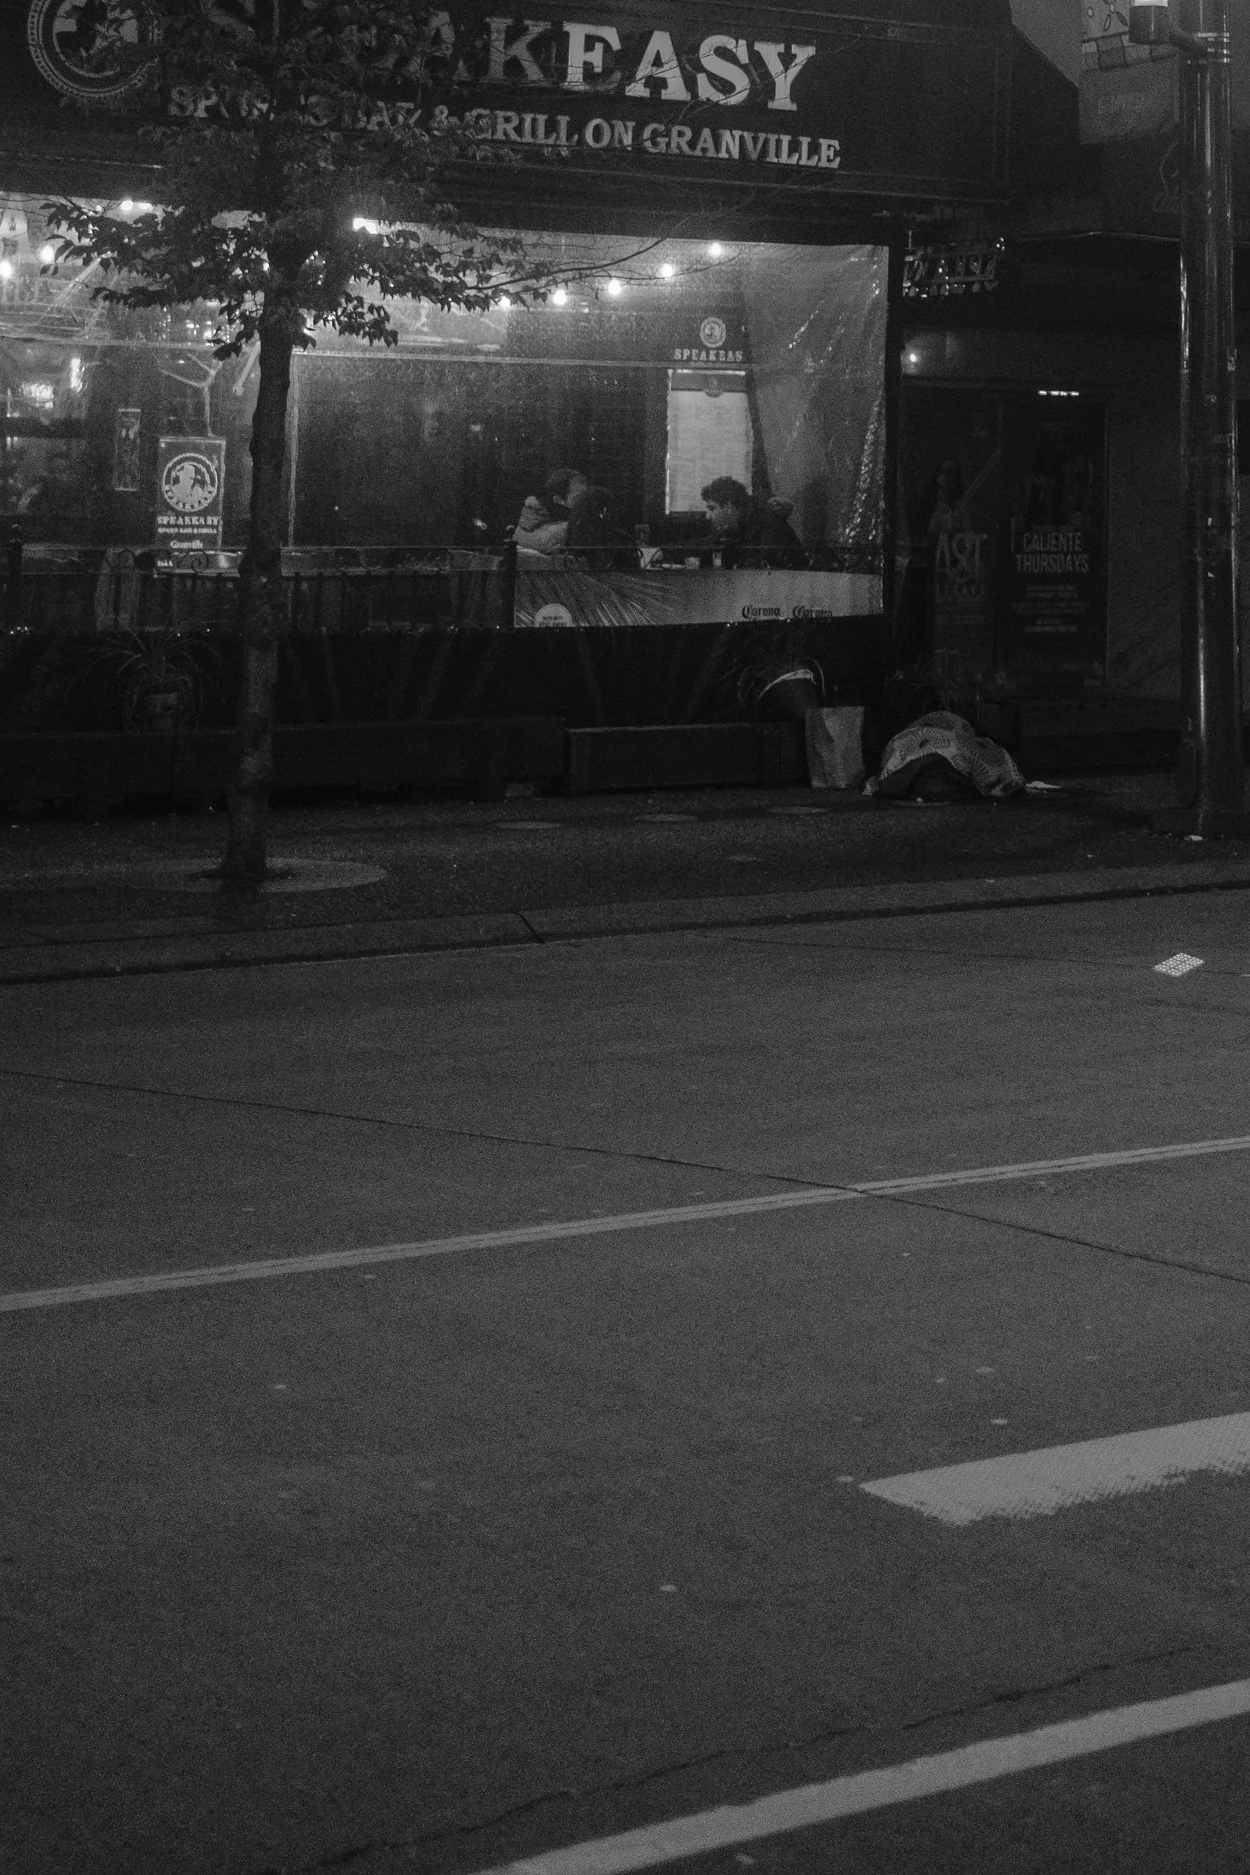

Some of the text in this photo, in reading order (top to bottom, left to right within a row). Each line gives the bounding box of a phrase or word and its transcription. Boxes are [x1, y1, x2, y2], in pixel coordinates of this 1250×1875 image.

[462, 107, 578, 147] GRILL
[584, 117, 636, 151] ON
[643, 122, 842, 169] GRANVILLE
[673, 348, 743, 363] SPEAKEAS
[1023, 532, 1082, 553] CALIENTE
[1015, 553, 1090, 573] THURSDAYS
[741, 604, 781, 619] Corona
